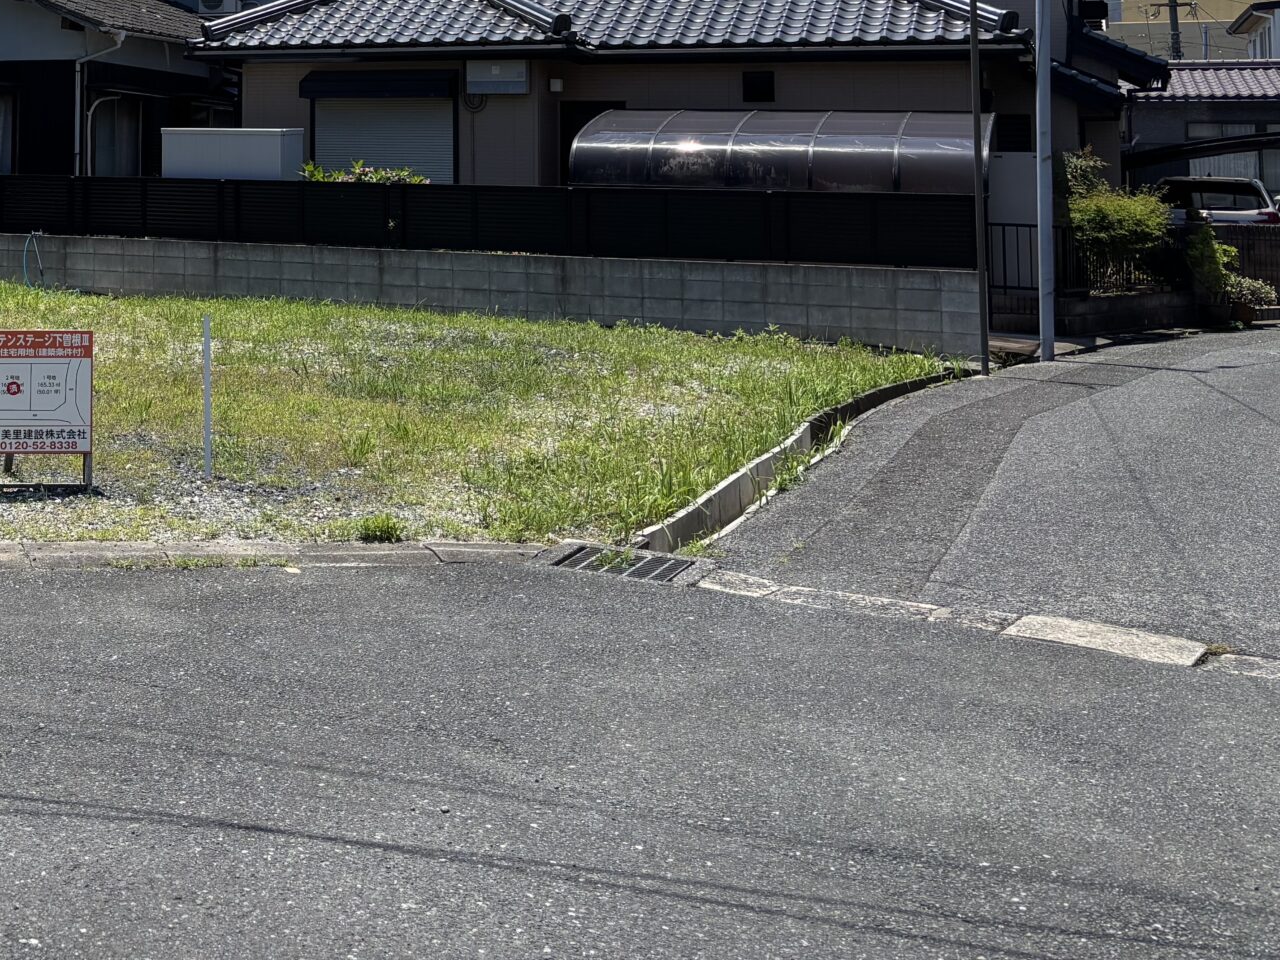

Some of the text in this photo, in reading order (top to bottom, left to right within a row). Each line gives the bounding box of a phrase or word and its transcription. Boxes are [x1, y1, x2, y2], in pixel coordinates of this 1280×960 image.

[1, 429, 87, 440] 美里建設株式会社
[0, 441, 78, 450] 0120-52-8338
